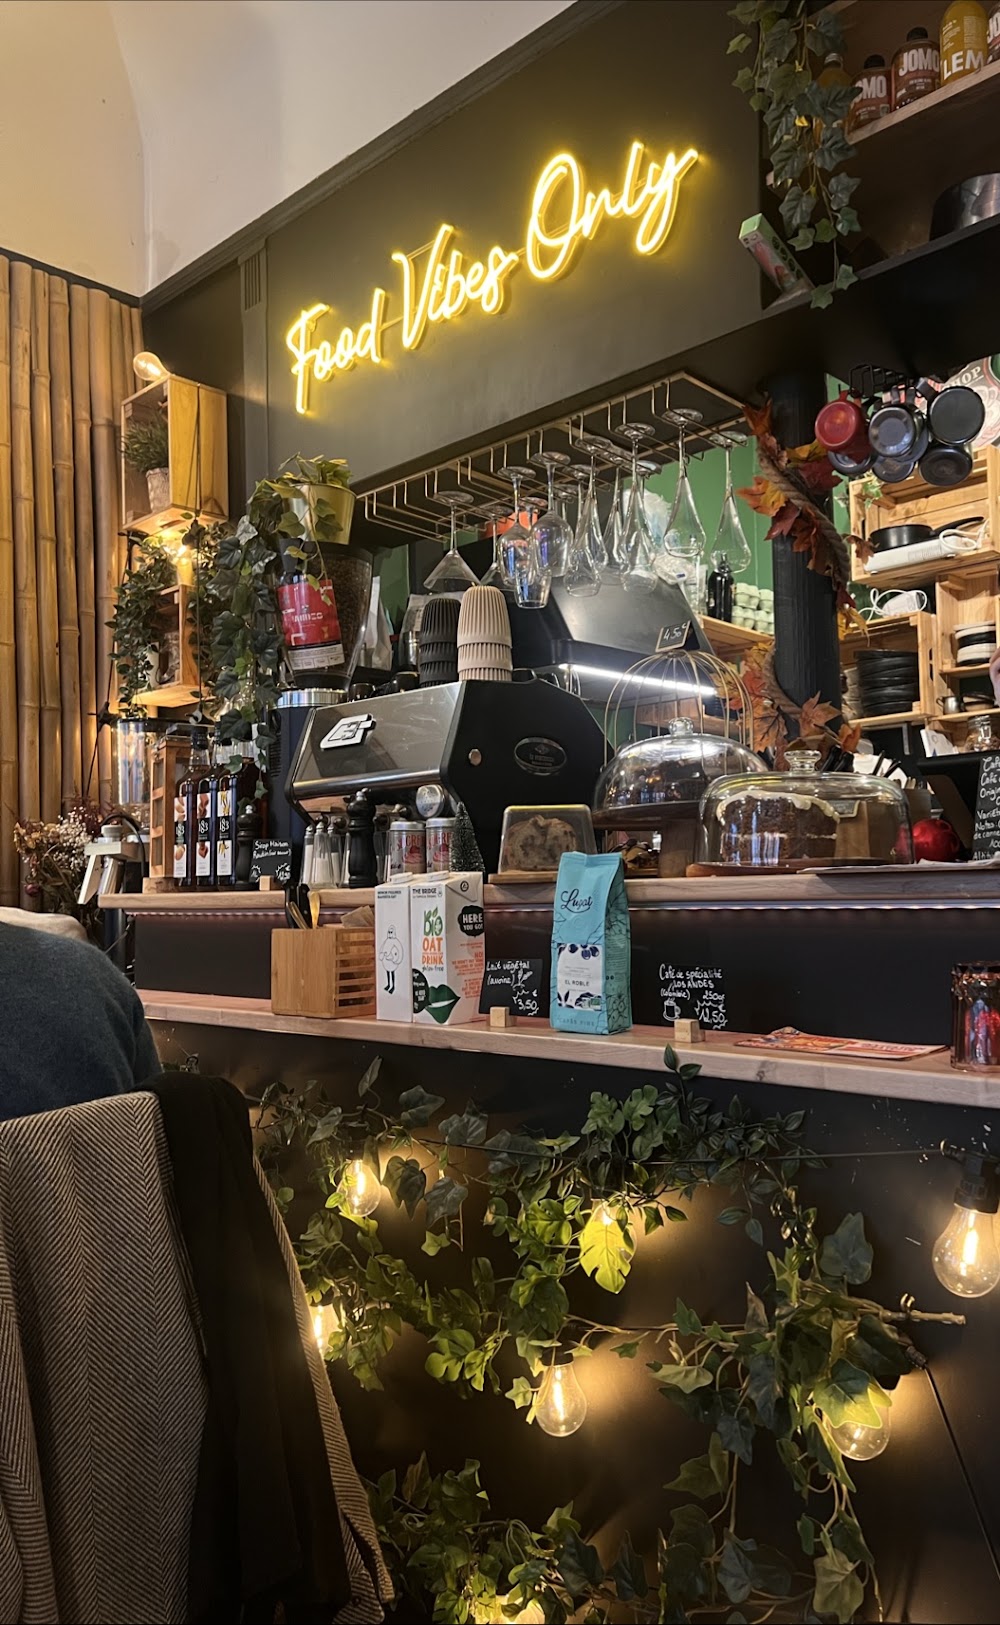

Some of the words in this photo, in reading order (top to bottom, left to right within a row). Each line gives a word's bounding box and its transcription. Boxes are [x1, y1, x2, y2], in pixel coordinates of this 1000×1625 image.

[899, 47, 940, 77] JOMO
[286, 288, 387, 414] Food
[392, 224, 519, 350] Vibes
[526, 141, 698, 279] Only
[462, 913, 483, 924] HERE
[422, 938, 443, 952] OAT
[422, 955, 443, 965] DRINK
[687, 979, 715, 989] ANDES
[518, 998, 538, 1011] 3,50
